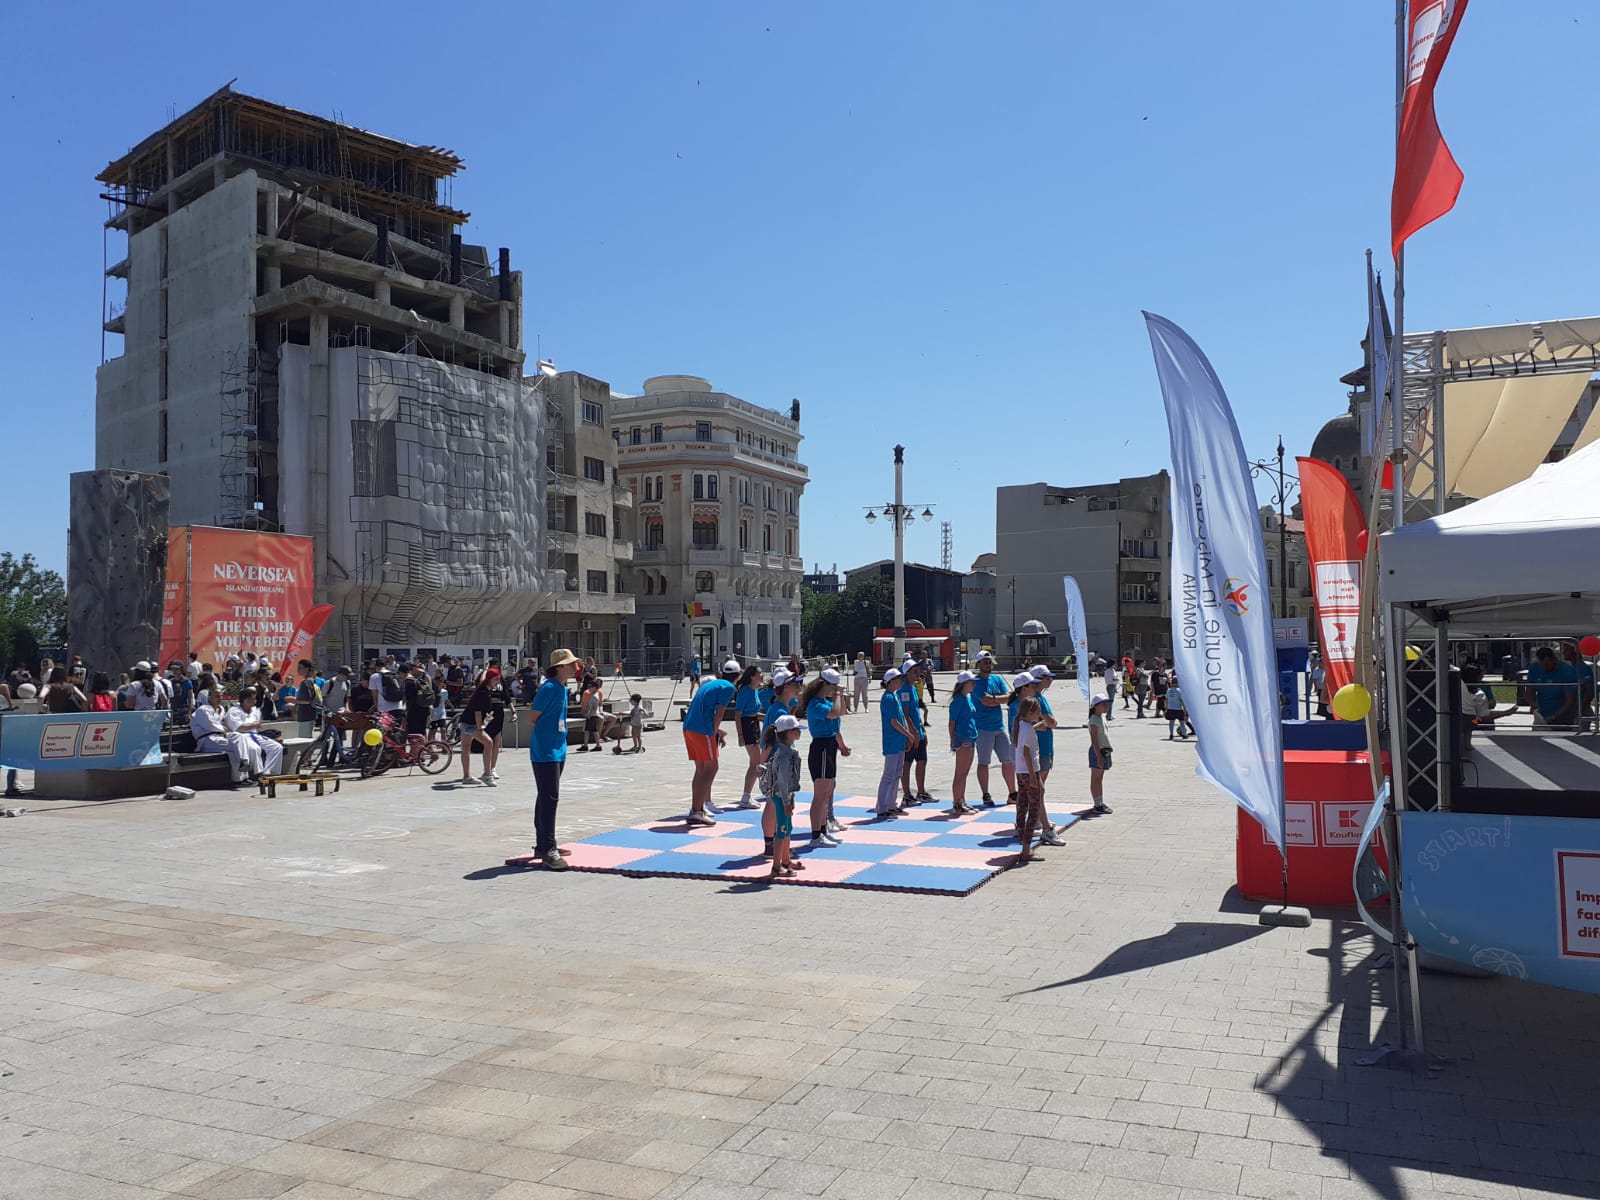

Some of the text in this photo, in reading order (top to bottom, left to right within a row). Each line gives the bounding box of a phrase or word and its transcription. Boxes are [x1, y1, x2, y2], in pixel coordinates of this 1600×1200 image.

[213, 560, 295, 583] NEVERSEA
[226, 584, 250, 592] ISLAND
[232, 605, 277, 617] THIS IS
[214, 620, 295, 633] THE SUMMER
[215, 635, 263, 648] YOU'VE
[271, 651, 287, 662] FO
[1417, 816, 1511, 872] START!
